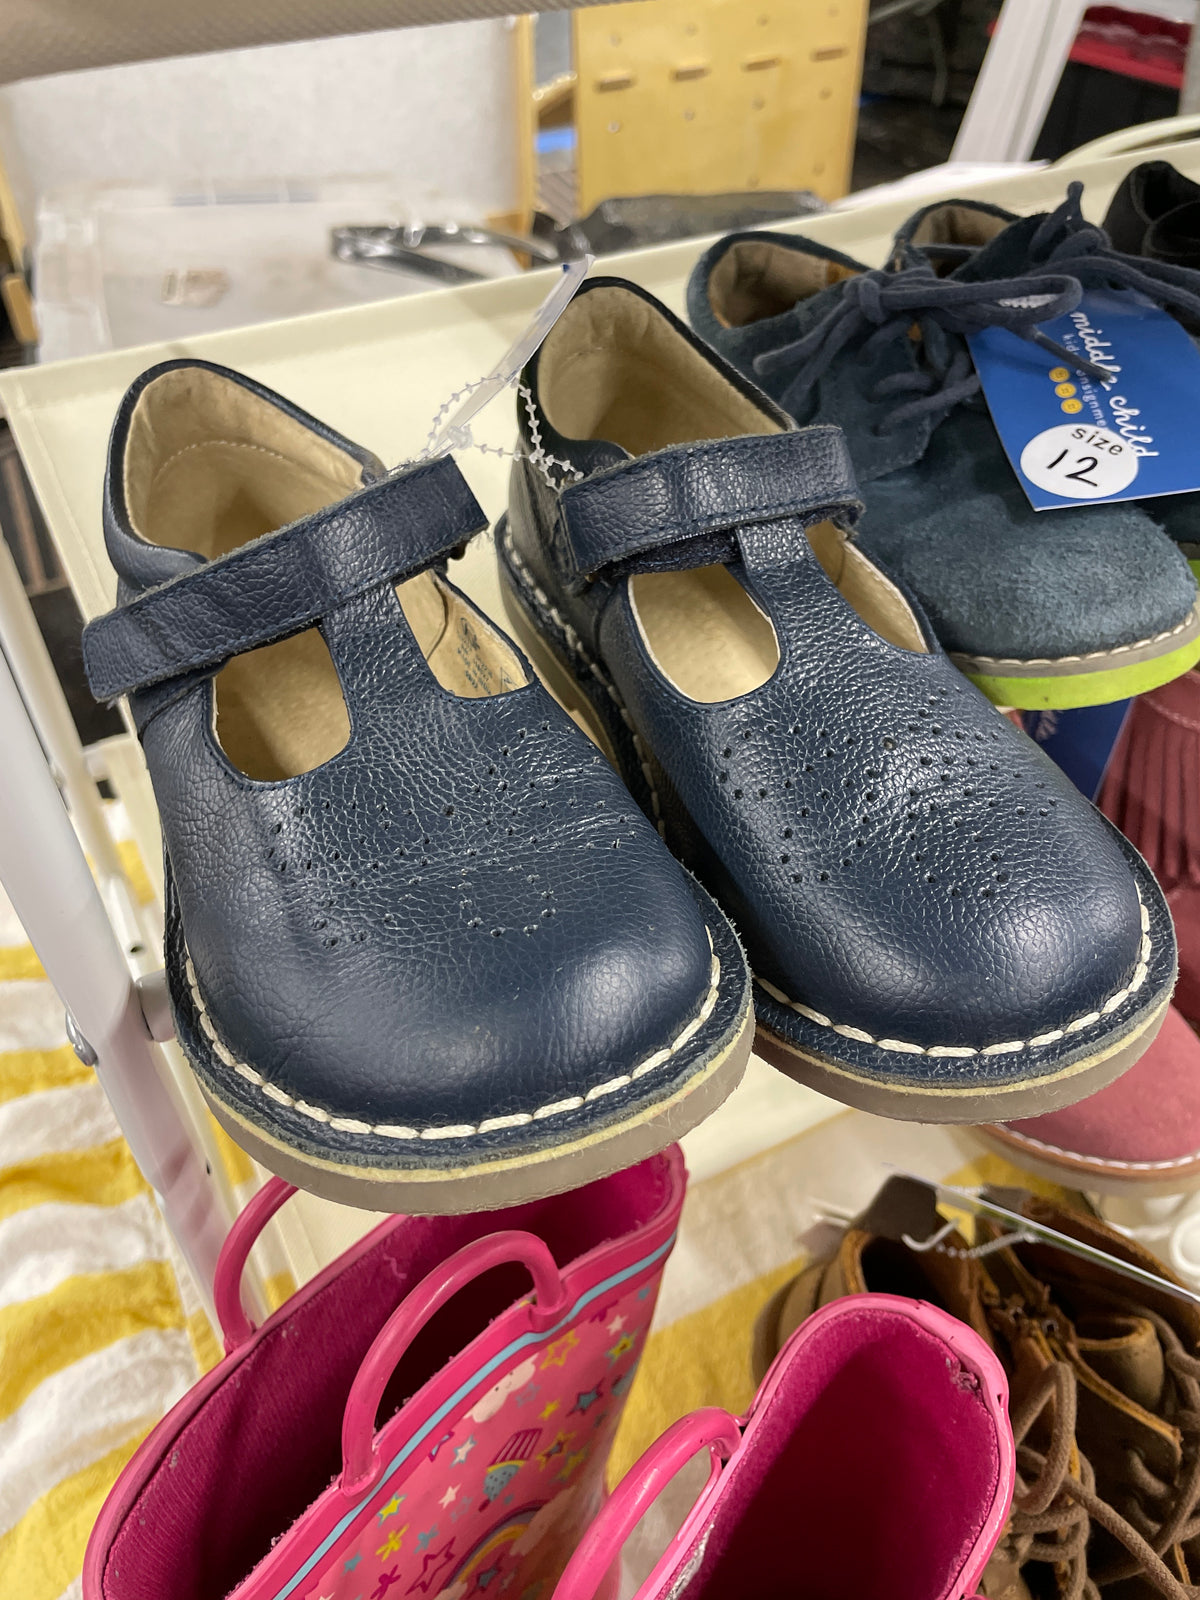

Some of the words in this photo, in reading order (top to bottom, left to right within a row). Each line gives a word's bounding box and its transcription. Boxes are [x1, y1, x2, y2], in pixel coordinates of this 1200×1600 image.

[1062, 333, 1080, 355] kid
[1071, 427, 1123, 456] size
[1109, 395, 1160, 457] child
[1046, 448, 1098, 488] 12
